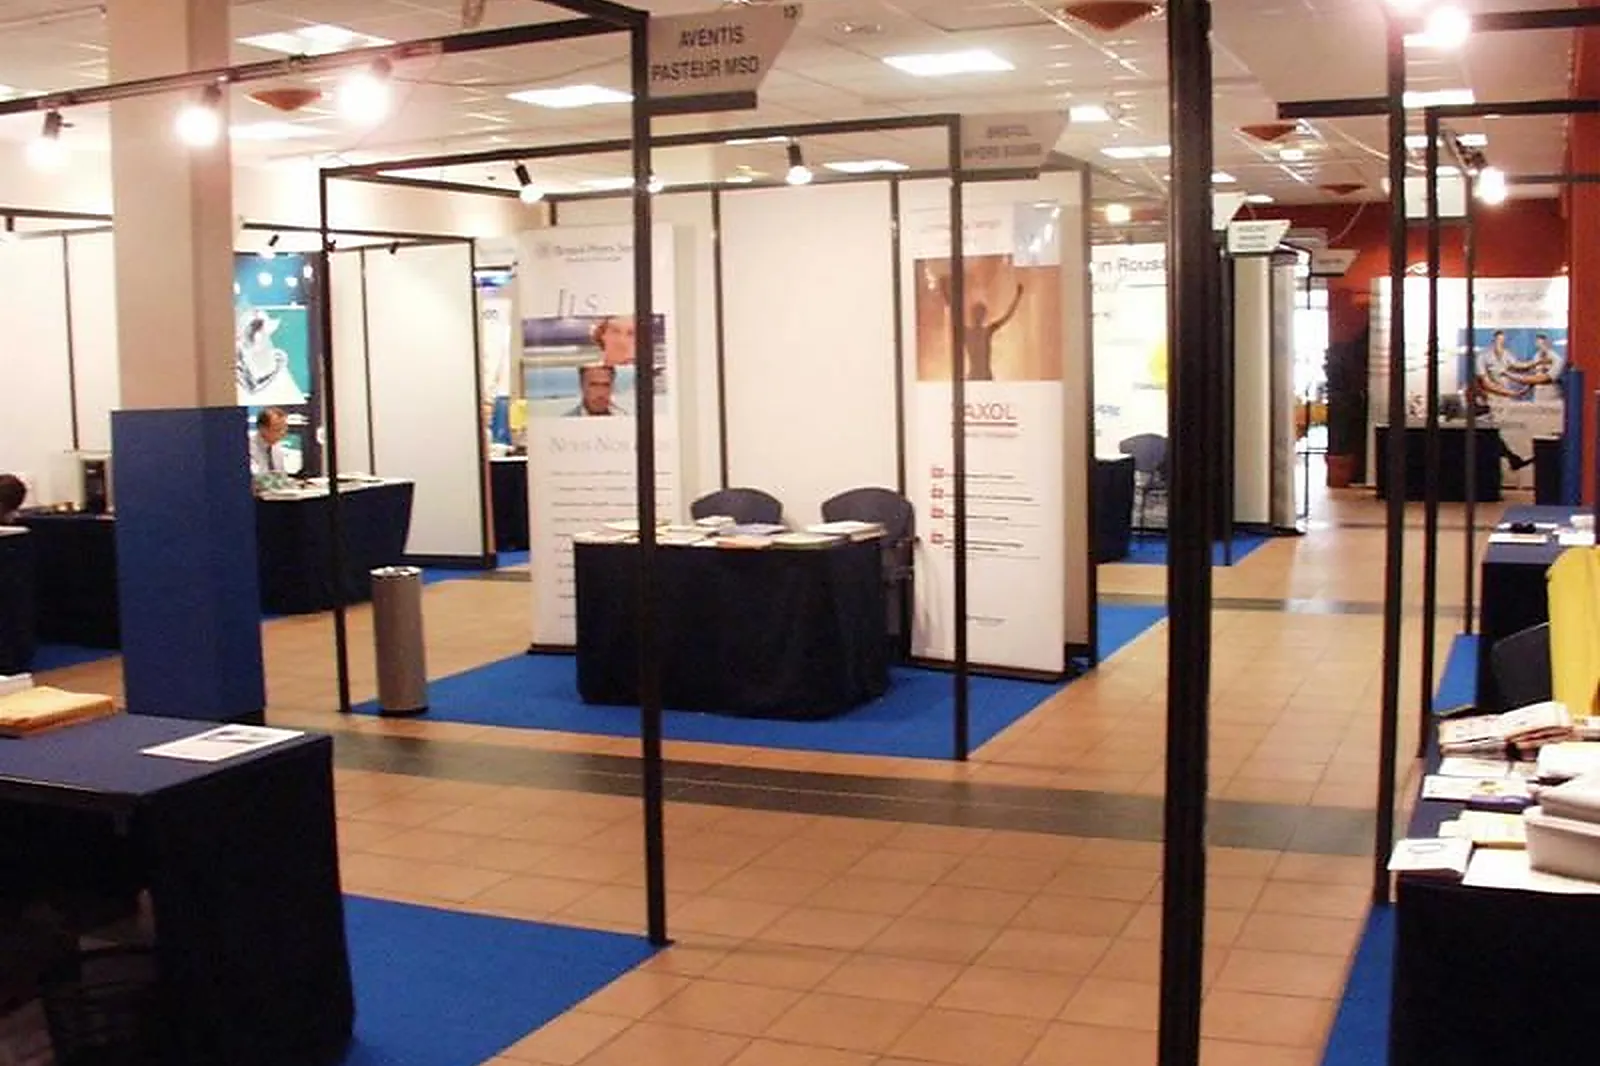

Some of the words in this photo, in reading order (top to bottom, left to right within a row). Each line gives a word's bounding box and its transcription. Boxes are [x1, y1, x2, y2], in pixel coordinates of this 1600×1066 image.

[680, 25, 744, 49] AVENTIS
[651, 59, 721, 82] PASTEUR
[725, 55, 760, 75] MSD
[952, 402, 1017, 420] AXOL
